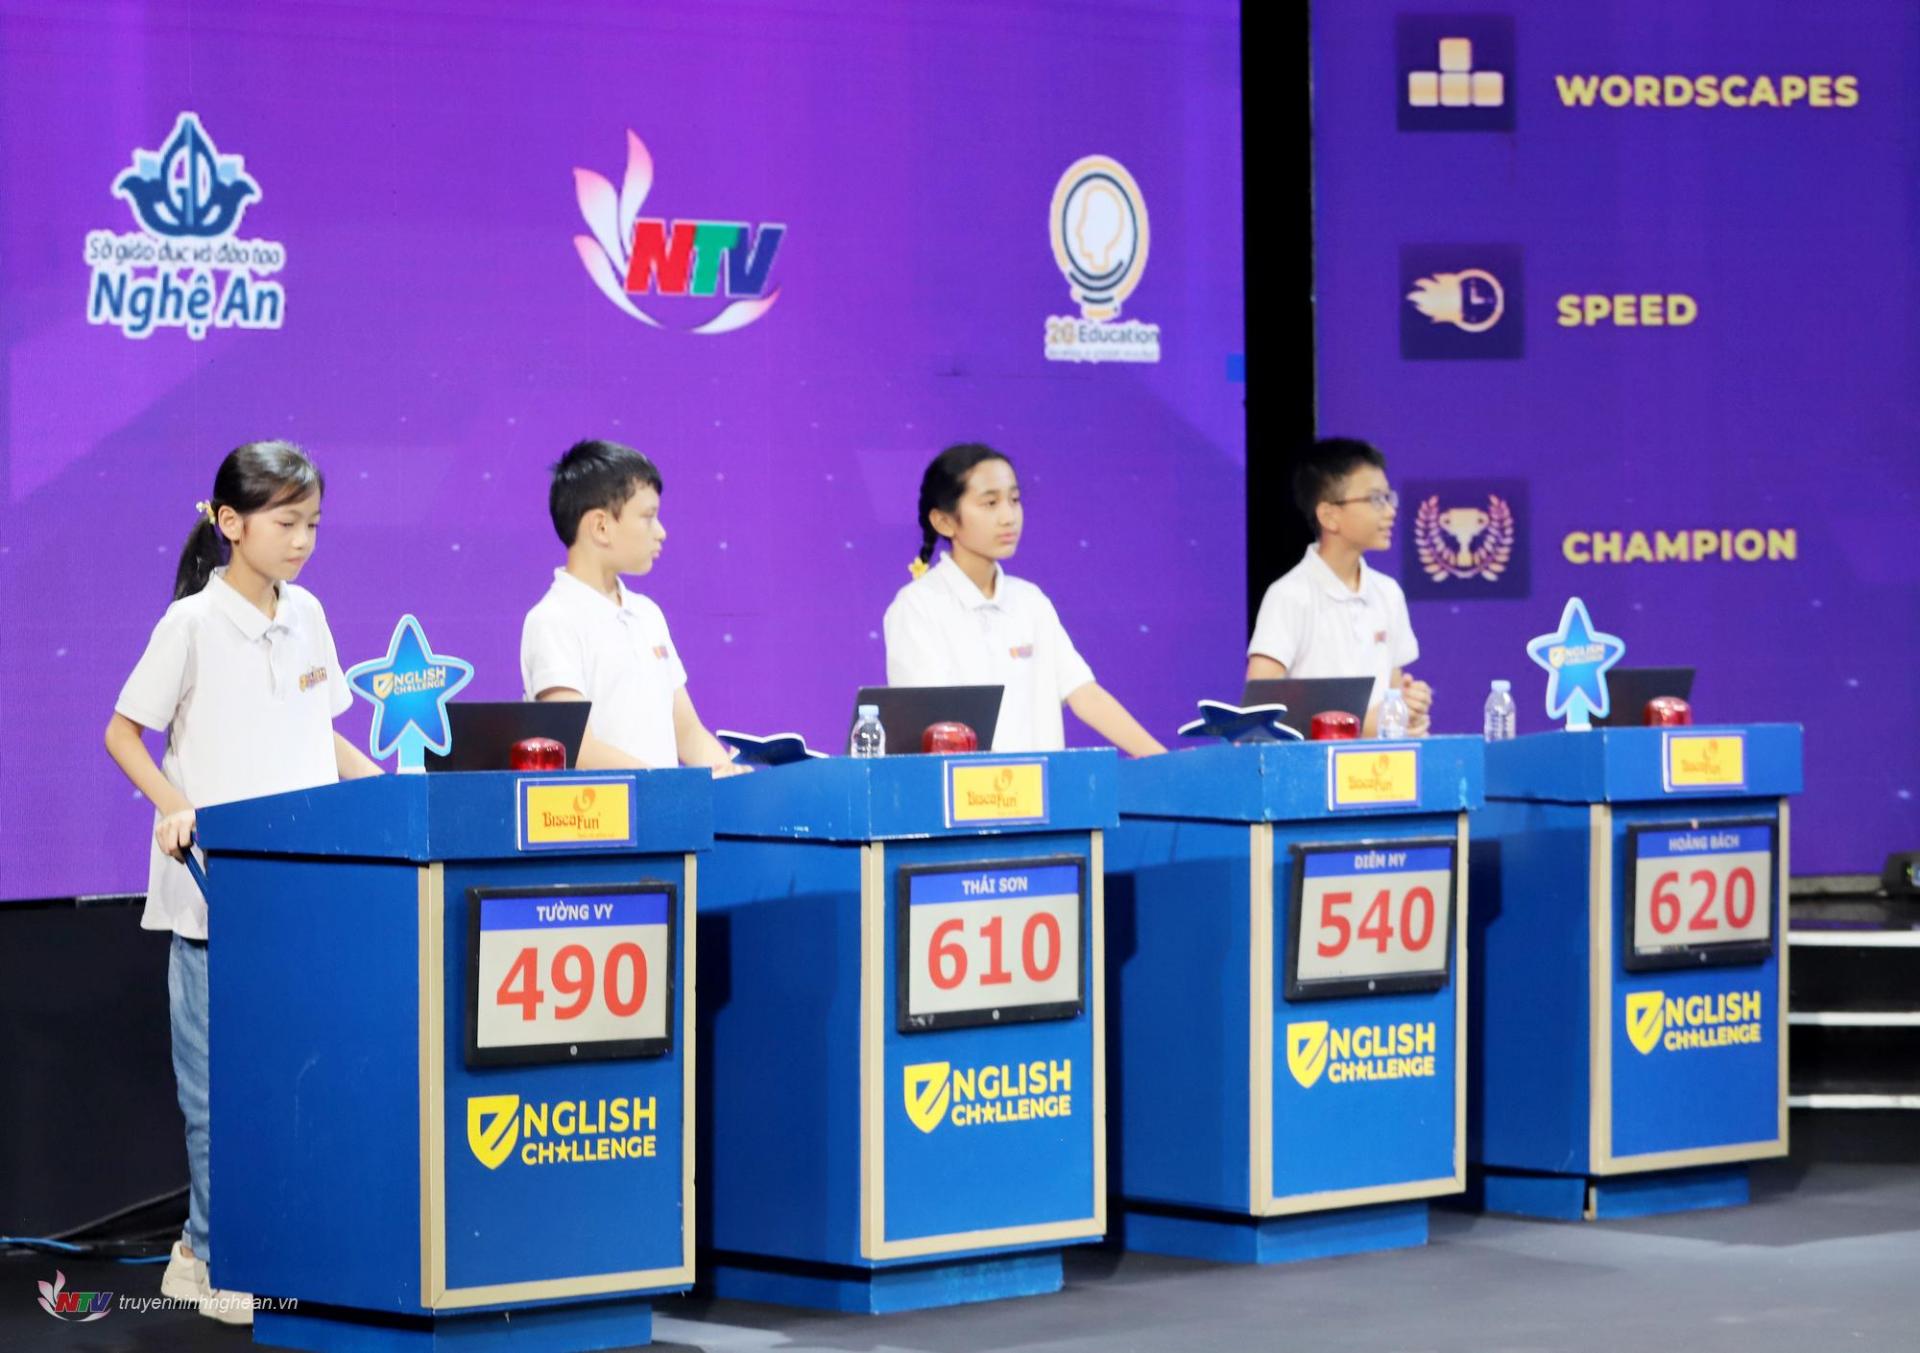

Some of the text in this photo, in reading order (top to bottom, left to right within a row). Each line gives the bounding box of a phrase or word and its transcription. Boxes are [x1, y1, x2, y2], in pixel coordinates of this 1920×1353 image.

[1555, 74, 1860, 108] WORDSCAPES
[624, 217, 788, 298] NTV
[93, 271, 280, 335] Nghệ An
[1556, 293, 1699, 328] SPEED
[1078, 323, 1159, 344] Education
[1561, 527, 1799, 566] CHAMPION
[962, 875, 1028, 895] THÁI SƠN
[1650, 865, 1756, 935] 620
[536, 901, 614, 922] TƯỜNG VY
[1317, 885, 1435, 959] 540
[928, 911, 1061, 991] 610
[496, 941, 648, 1022] 490
